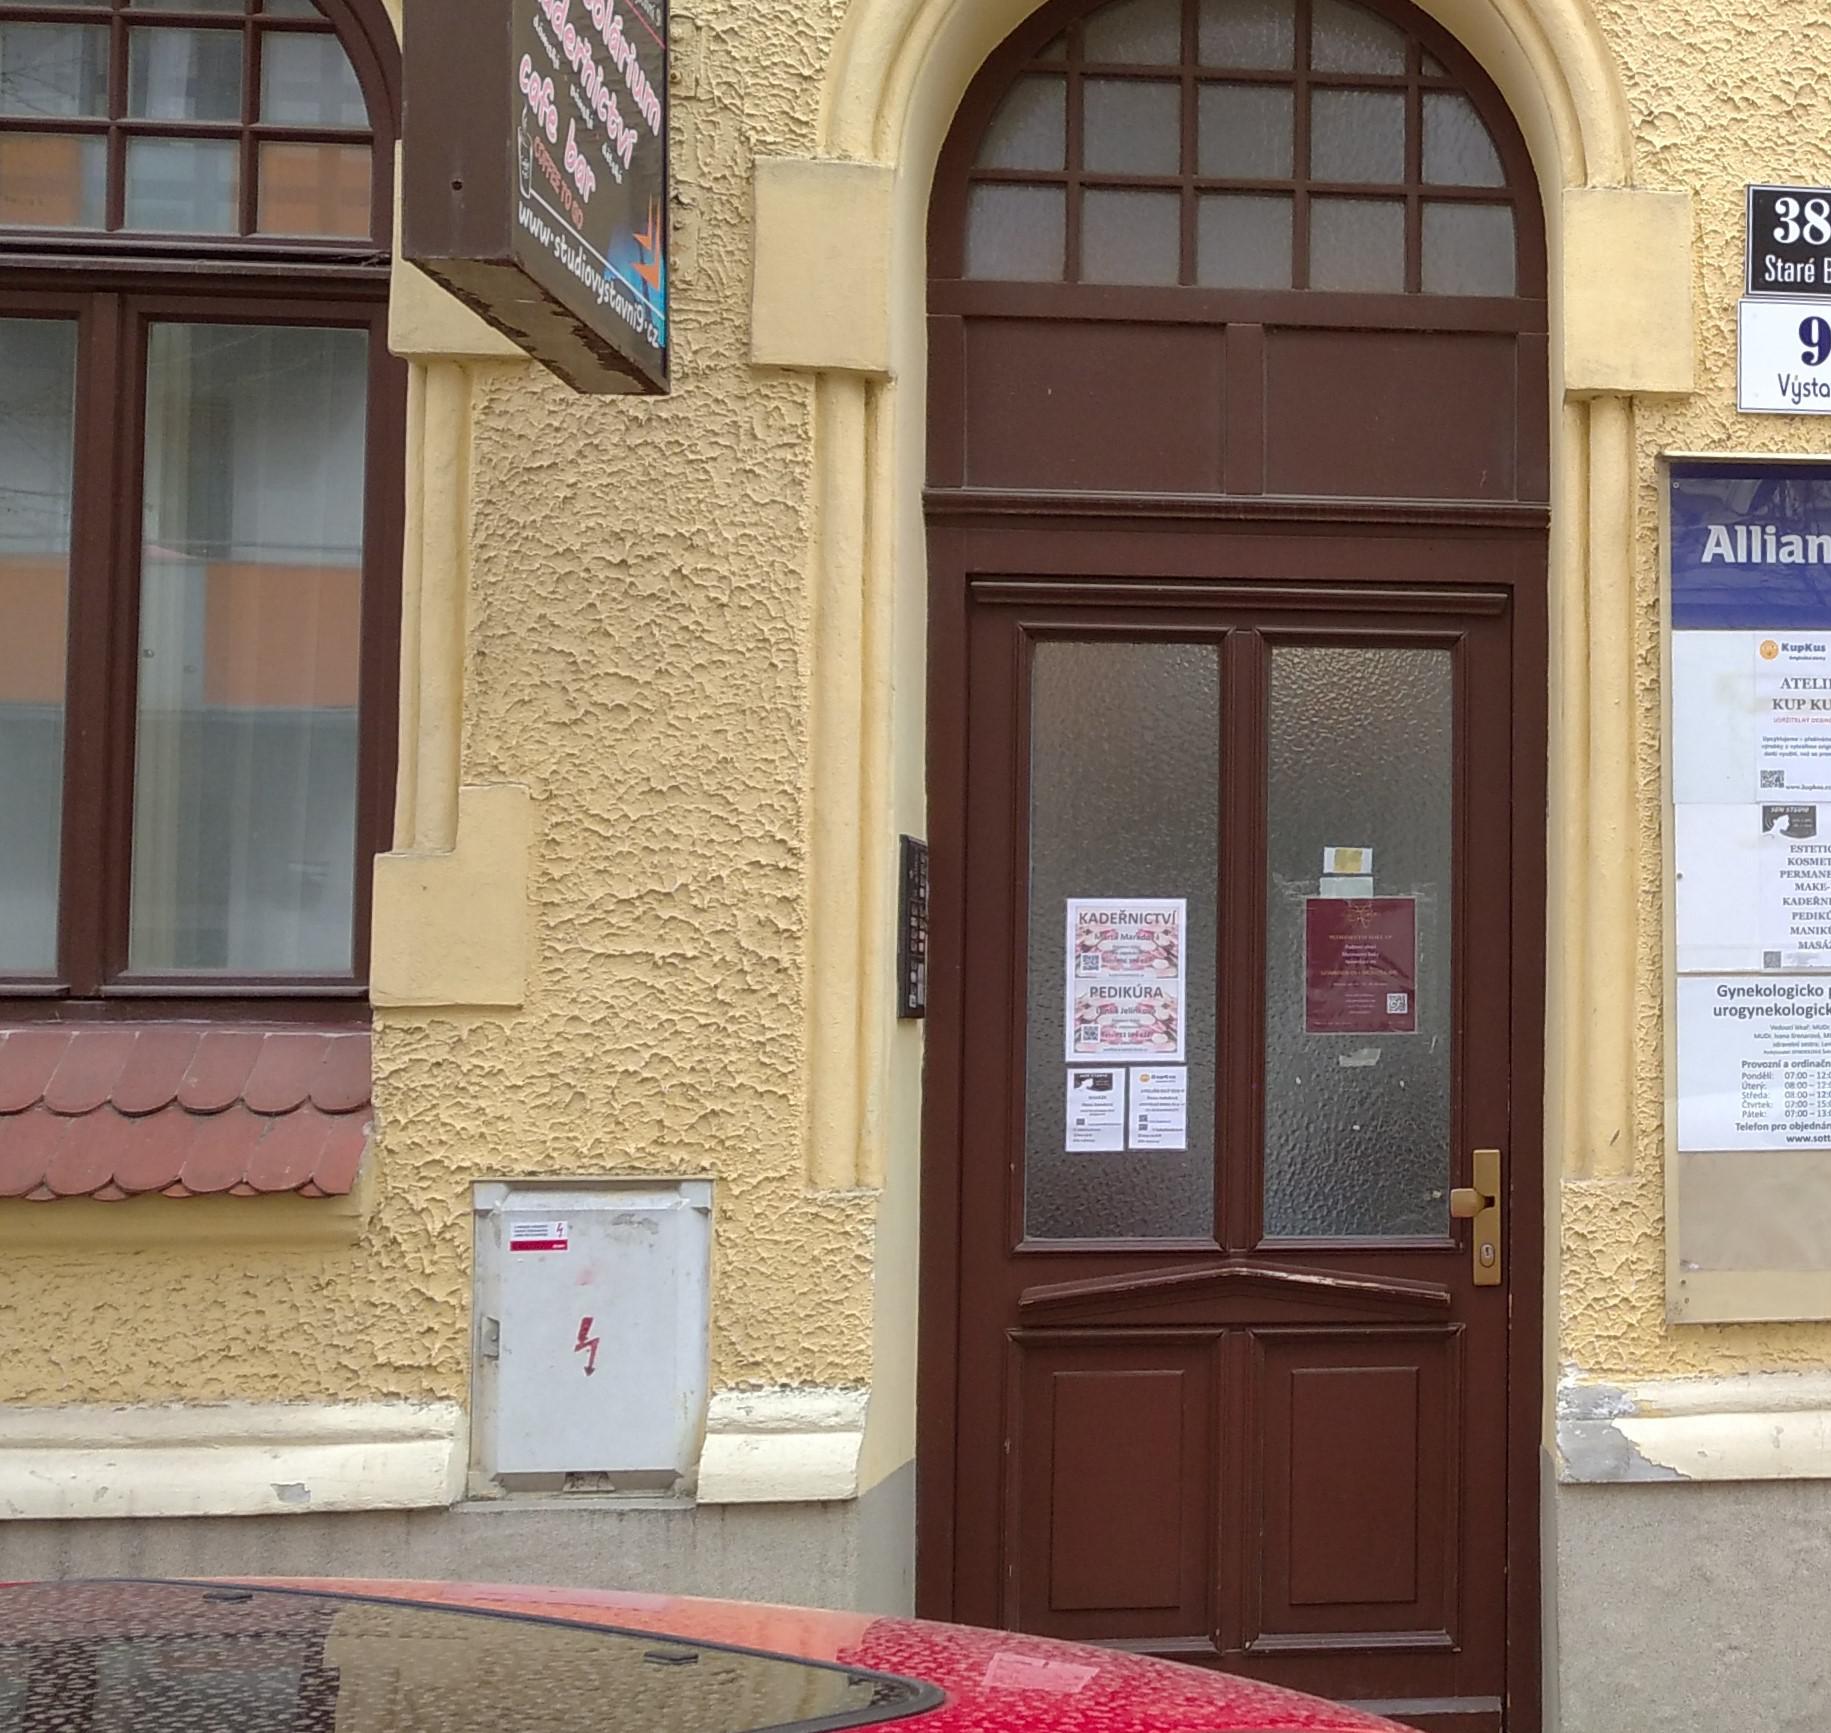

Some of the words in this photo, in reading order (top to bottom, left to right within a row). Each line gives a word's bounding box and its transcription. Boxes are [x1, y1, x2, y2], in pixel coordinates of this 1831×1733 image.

[583, 0, 661, 136] olárium
[538, 0, 638, 170] deřnictví
[564, 117, 598, 204] bar
[1764, 254, 1815, 283] Staré
[1781, 643, 1826, 653] KupKus
[1773, 698, 1806, 710] KUP
[1079, 910, 1176, 925] KADEŘNICTVÍ
[1090, 984, 1163, 999] PEDIKÚRA
[1717, 984, 1824, 1000] Gynekologicko
[1742, 1060, 1781, 1069] Provozní
[1736, 1122, 1769, 1131] Telefon
[1771, 1124, 1787, 1132] pro
